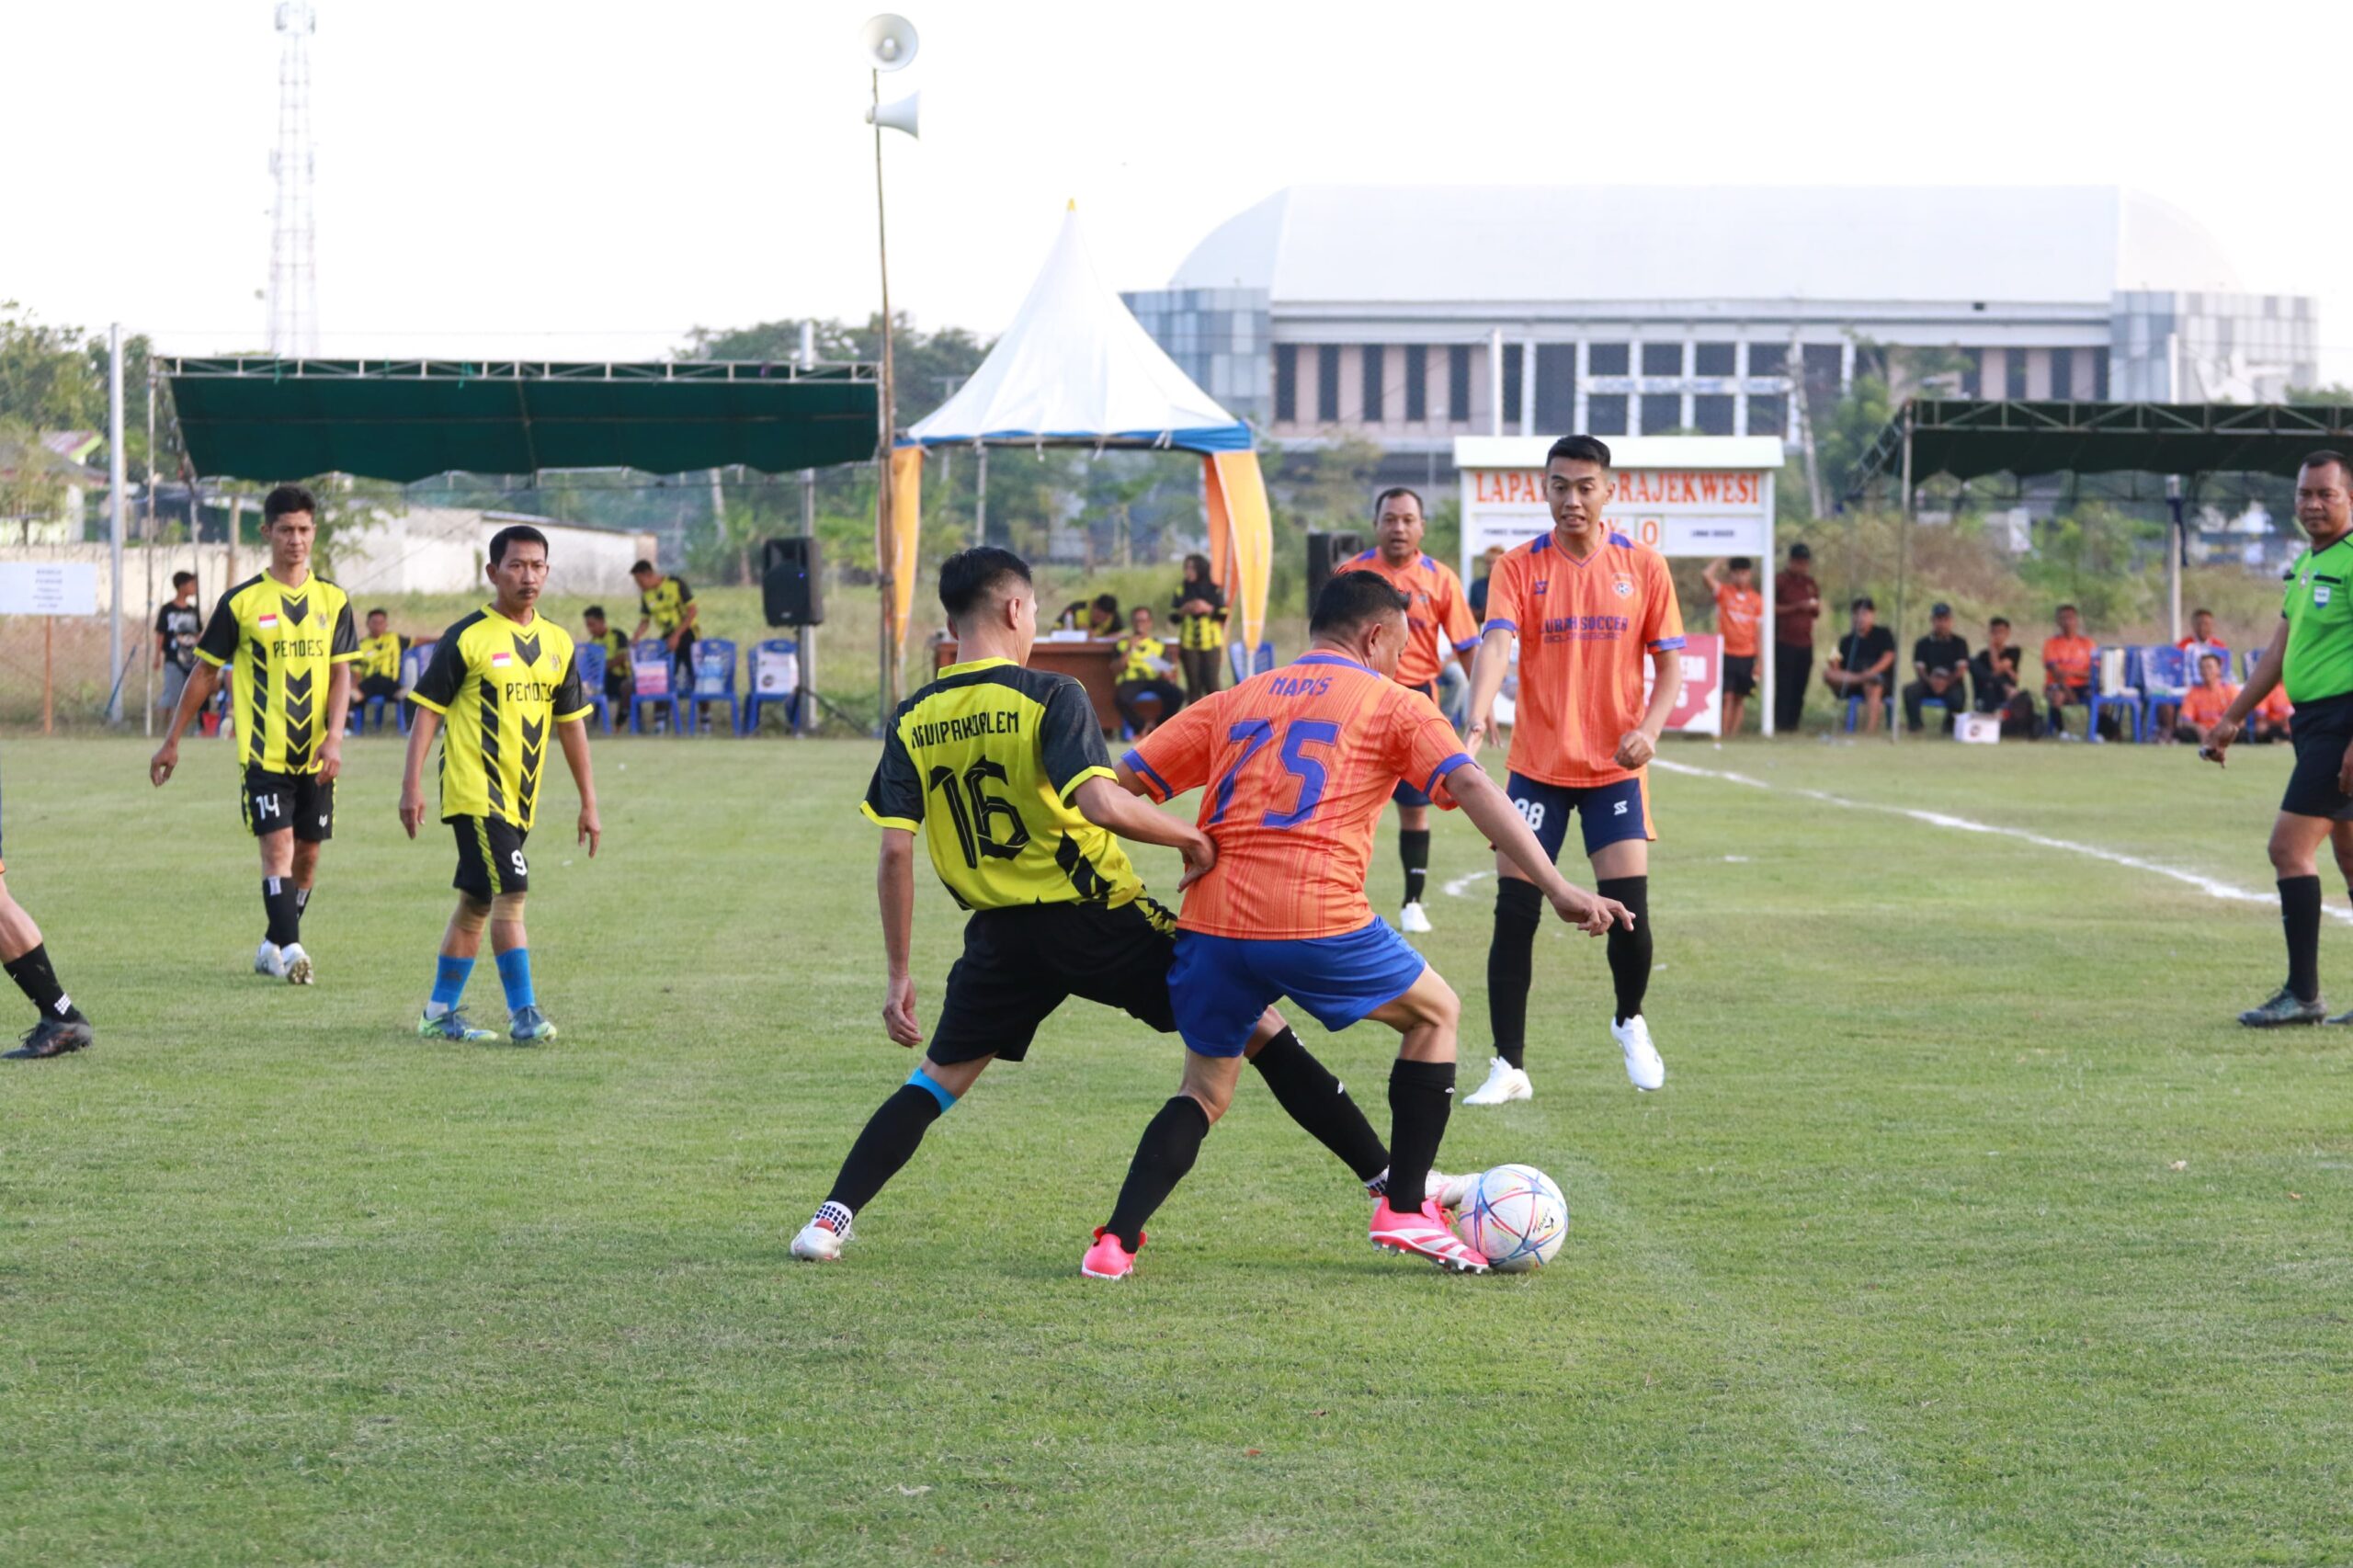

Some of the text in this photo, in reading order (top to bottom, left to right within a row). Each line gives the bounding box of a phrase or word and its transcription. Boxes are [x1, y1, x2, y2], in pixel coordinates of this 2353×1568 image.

[1475, 471, 1758, 504] LAPA RAJEKWESI
[1540, 615, 1628, 634] URAH SOCCER
[1205, 717, 1343, 831] 75
[256, 793, 280, 820] 14
[929, 754, 1031, 869] 16
[511, 849, 528, 876] 9
